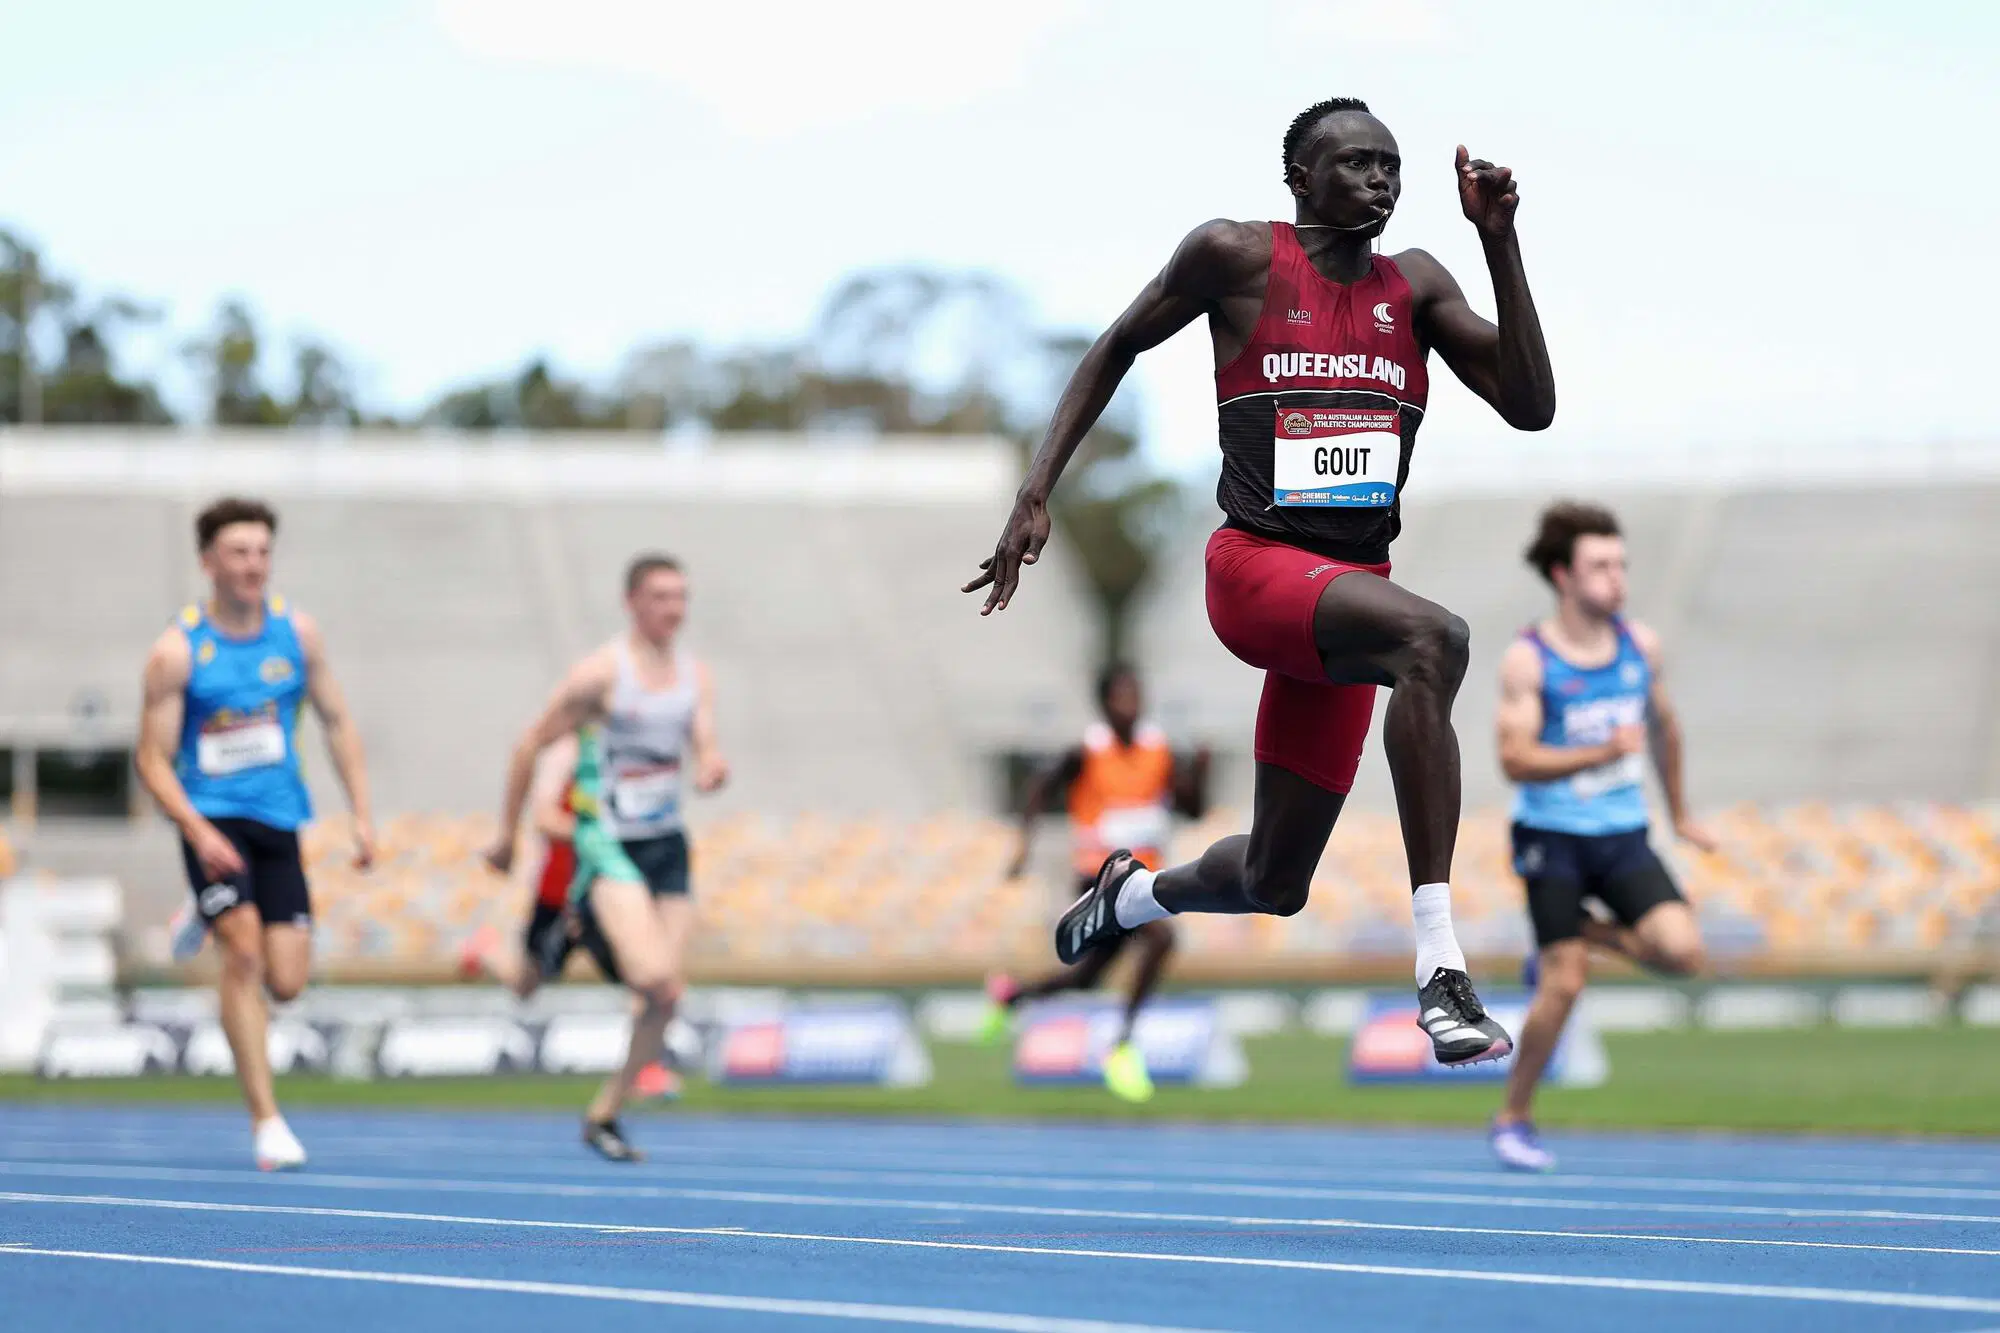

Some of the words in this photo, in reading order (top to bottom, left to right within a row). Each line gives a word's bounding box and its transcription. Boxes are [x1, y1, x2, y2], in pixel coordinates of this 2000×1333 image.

[1288, 309, 1311, 320] IMPI
[1263, 353, 1406, 391] QUEENSLAND
[1313, 420, 1347, 428] ATHLETICS
[1347, 421, 1393, 429] CHAMPIONSHIPS
[1314, 447, 1371, 476] GOUT
